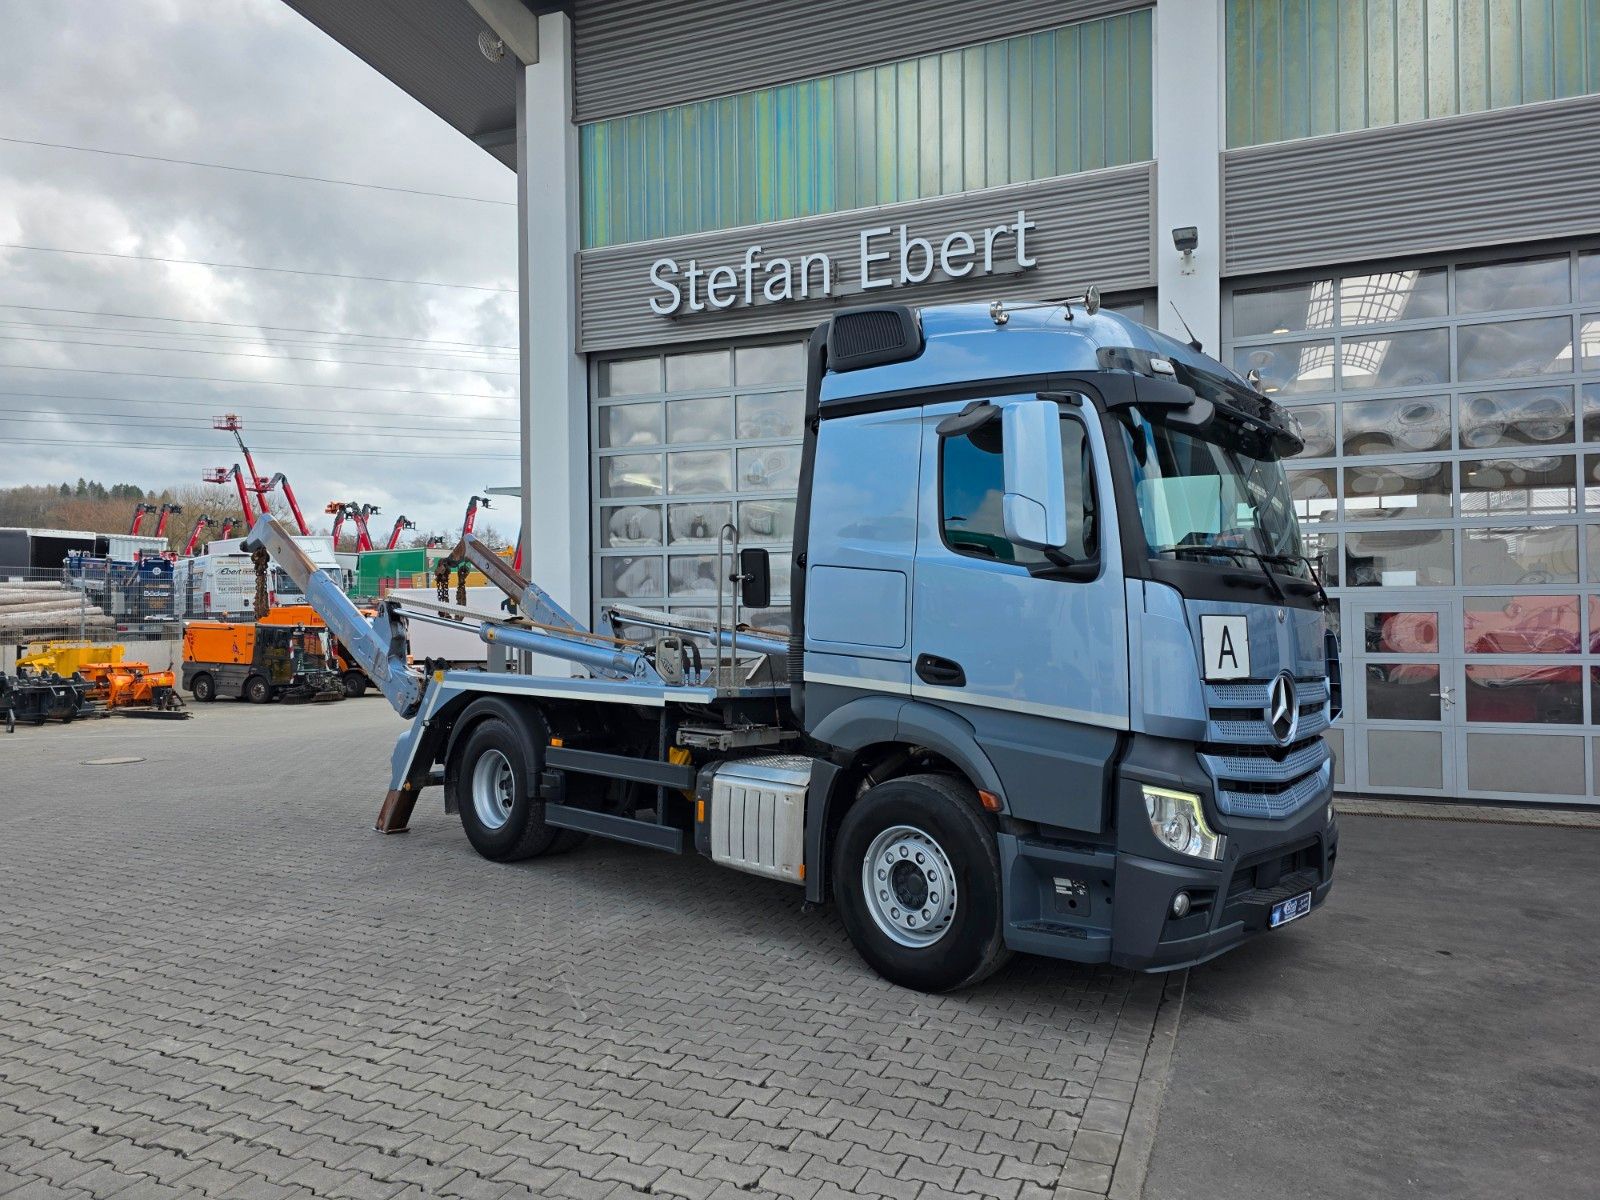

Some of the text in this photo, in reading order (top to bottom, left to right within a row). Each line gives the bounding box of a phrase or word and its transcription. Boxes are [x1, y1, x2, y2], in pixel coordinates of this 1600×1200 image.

[648, 209, 1038, 316] Stefan Ebert
[1218, 625, 1239, 669] A
